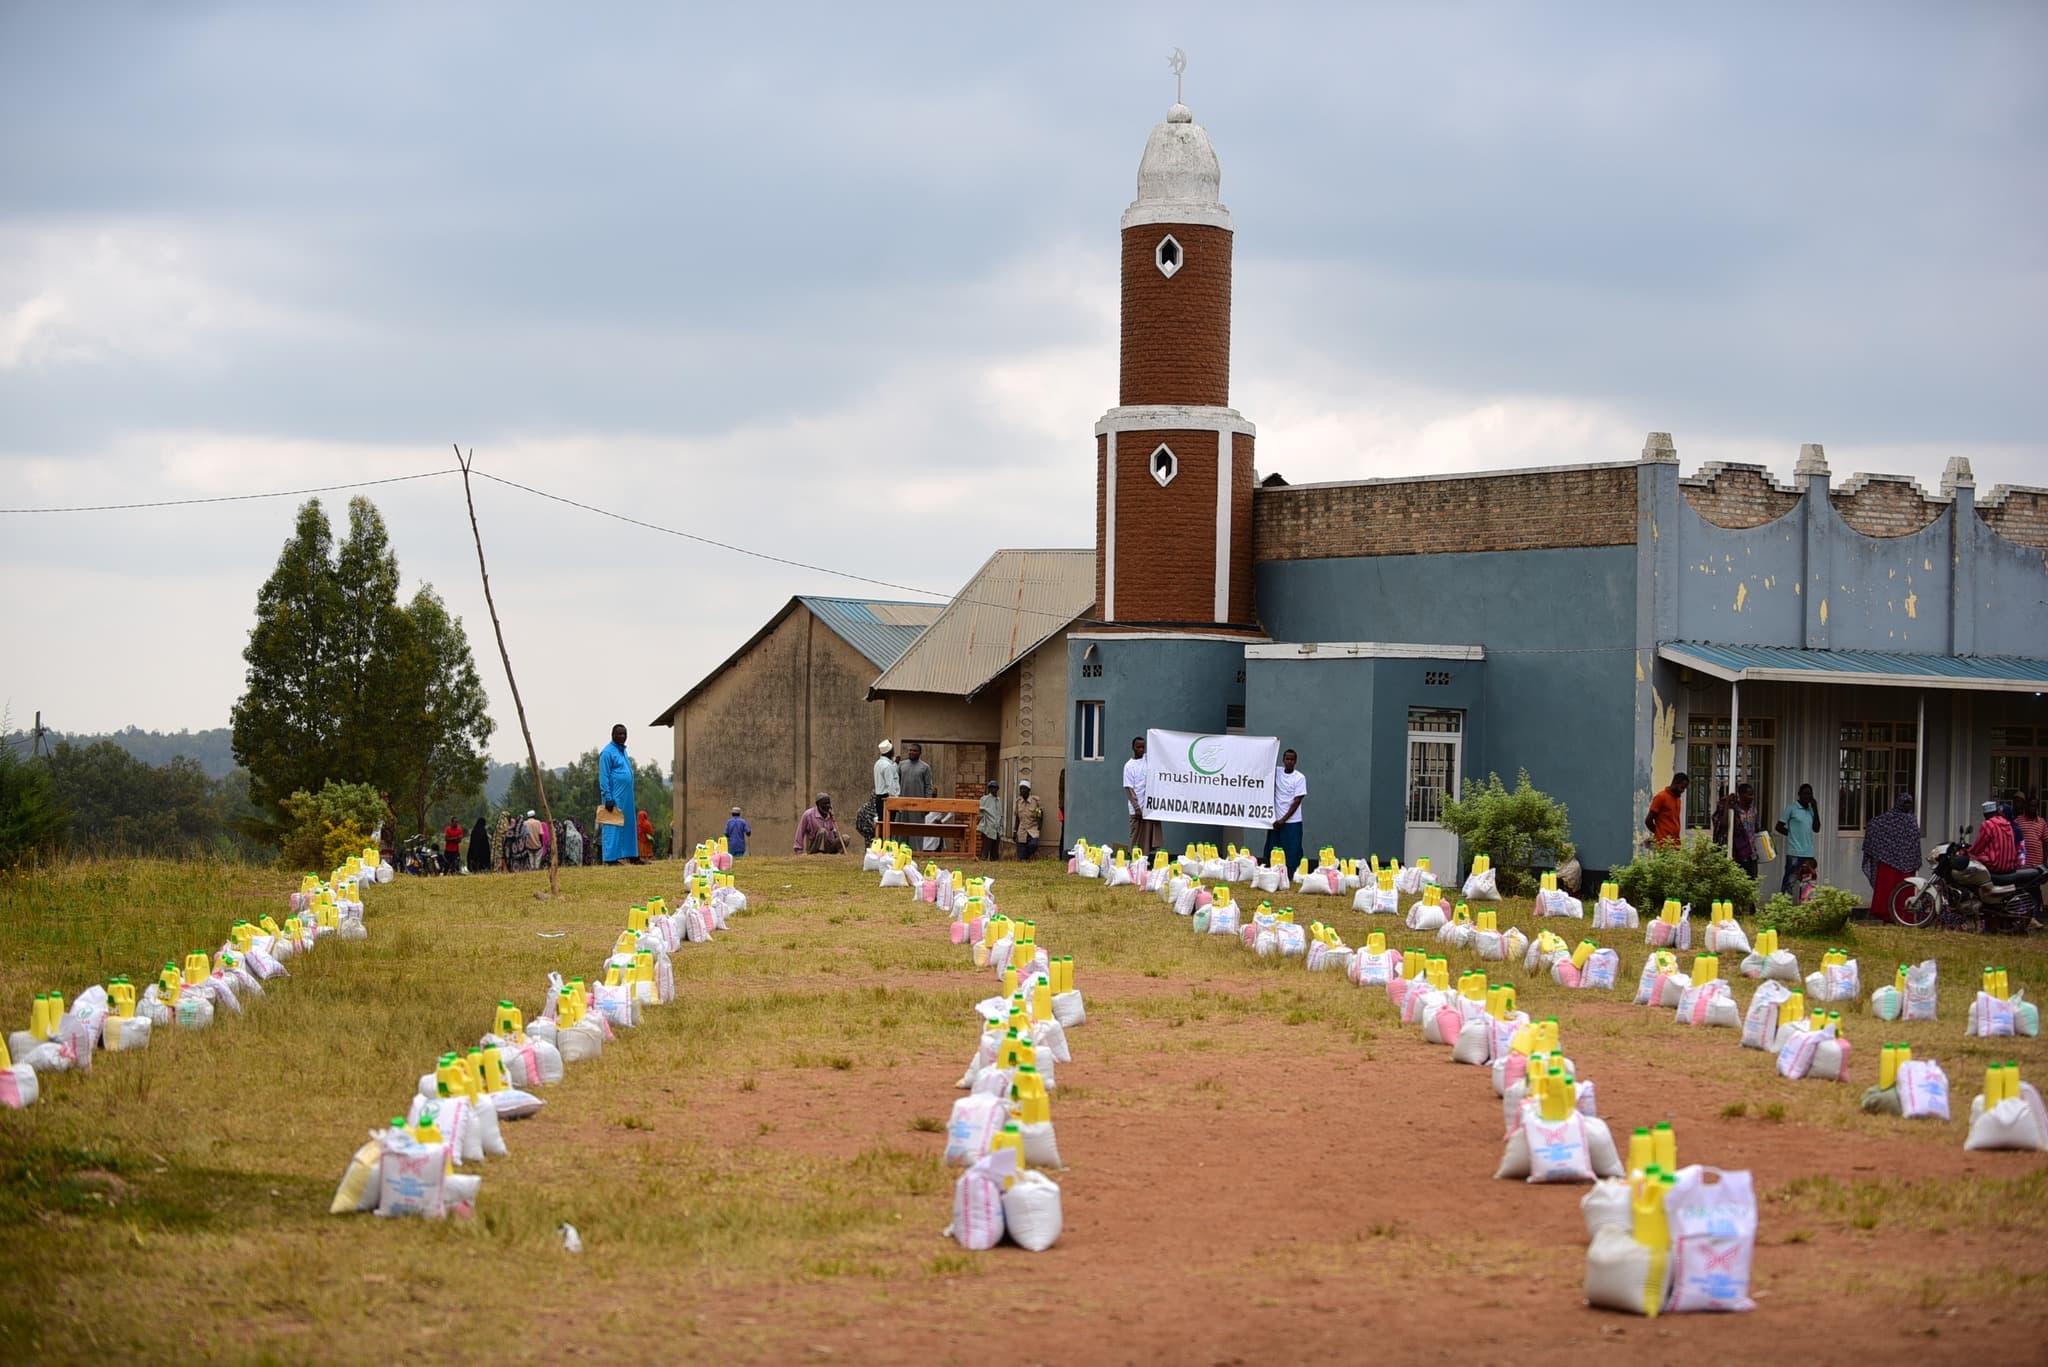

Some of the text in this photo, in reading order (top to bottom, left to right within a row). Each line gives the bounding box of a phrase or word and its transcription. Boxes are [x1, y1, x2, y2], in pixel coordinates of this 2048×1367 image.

[1159, 771, 1264, 788] muslimehelfen
[1146, 796, 1273, 818] RUANDA/RAMADAN 2025
